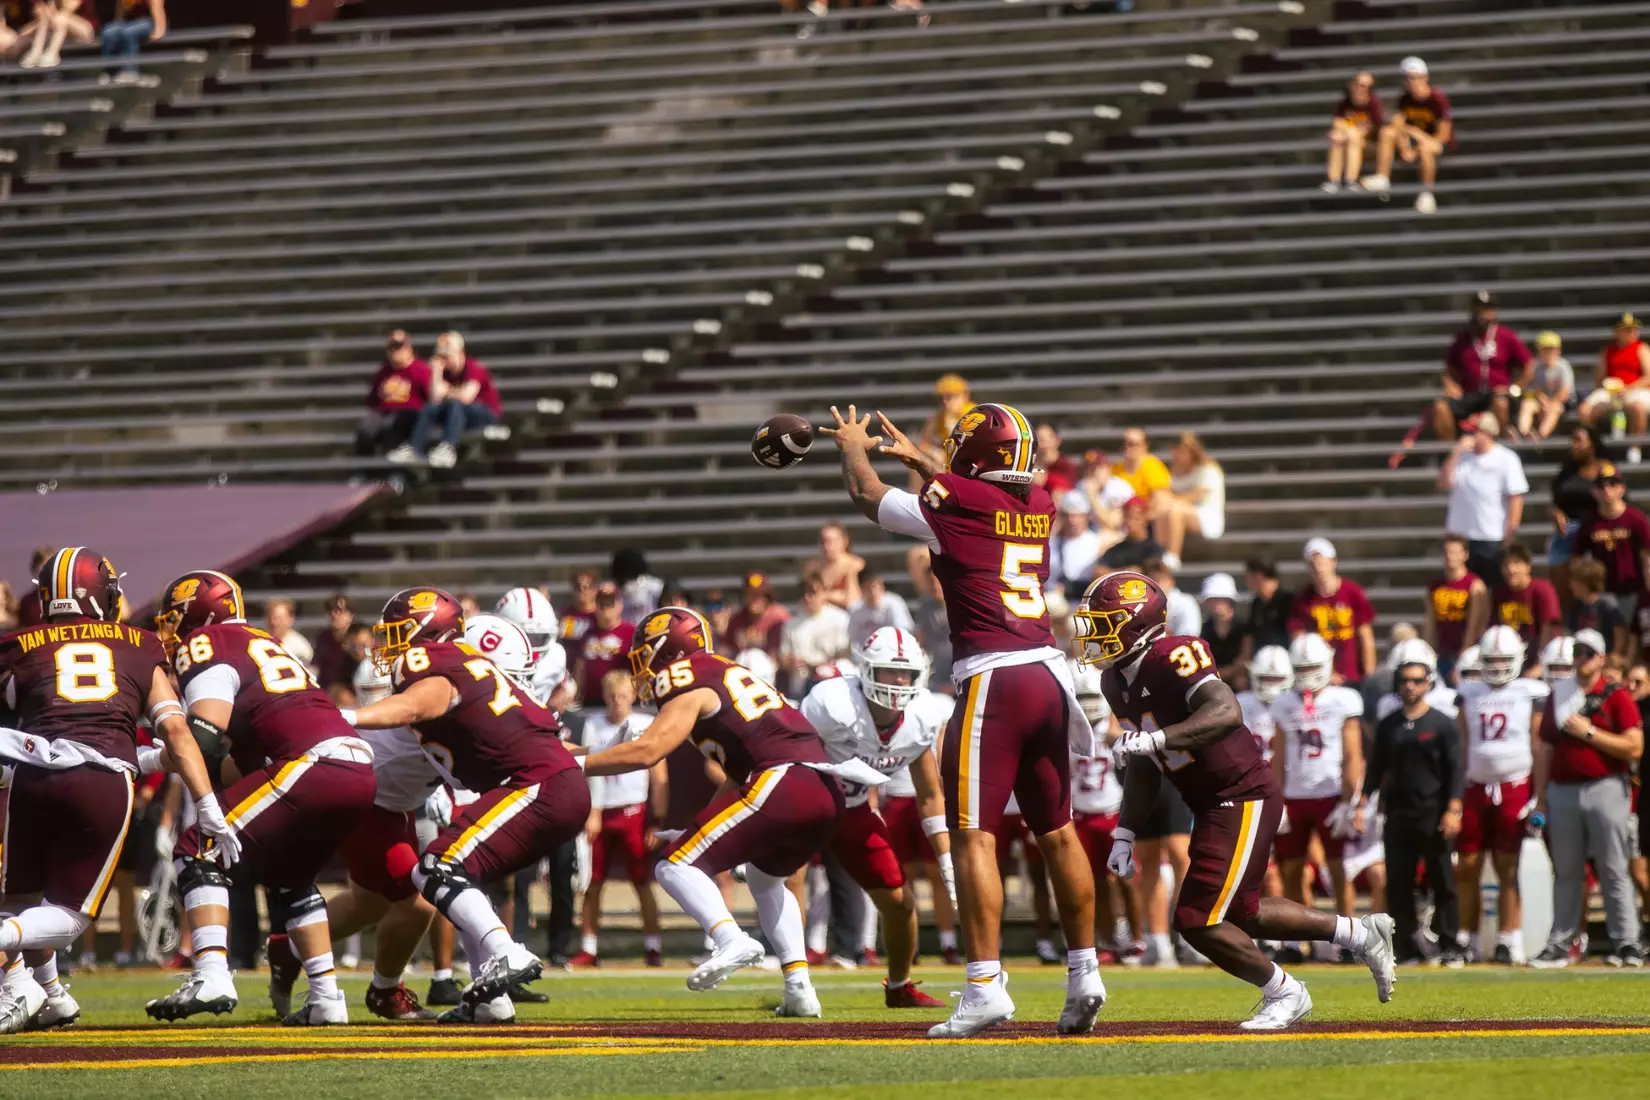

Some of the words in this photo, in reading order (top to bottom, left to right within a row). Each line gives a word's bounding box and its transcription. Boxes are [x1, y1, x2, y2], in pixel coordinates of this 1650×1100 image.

[923, 479, 950, 509] 5
[995, 510, 1050, 538] GLASSER
[1000, 541, 1046, 619] 5
[53, 602, 73, 610] LOVE
[17, 629, 46, 651] VAN
[47, 623, 124, 643] WETZINGA
[128, 627, 142, 648] IV
[175, 633, 214, 676] 66
[55, 642, 119, 702] 8
[247, 637, 320, 694] 6
[655, 658, 695, 698] 85
[1168, 639, 1213, 678] 31
[463, 658, 547, 717] 7
[723, 665, 798, 723] 8
[1479, 713, 1508, 741] 12
